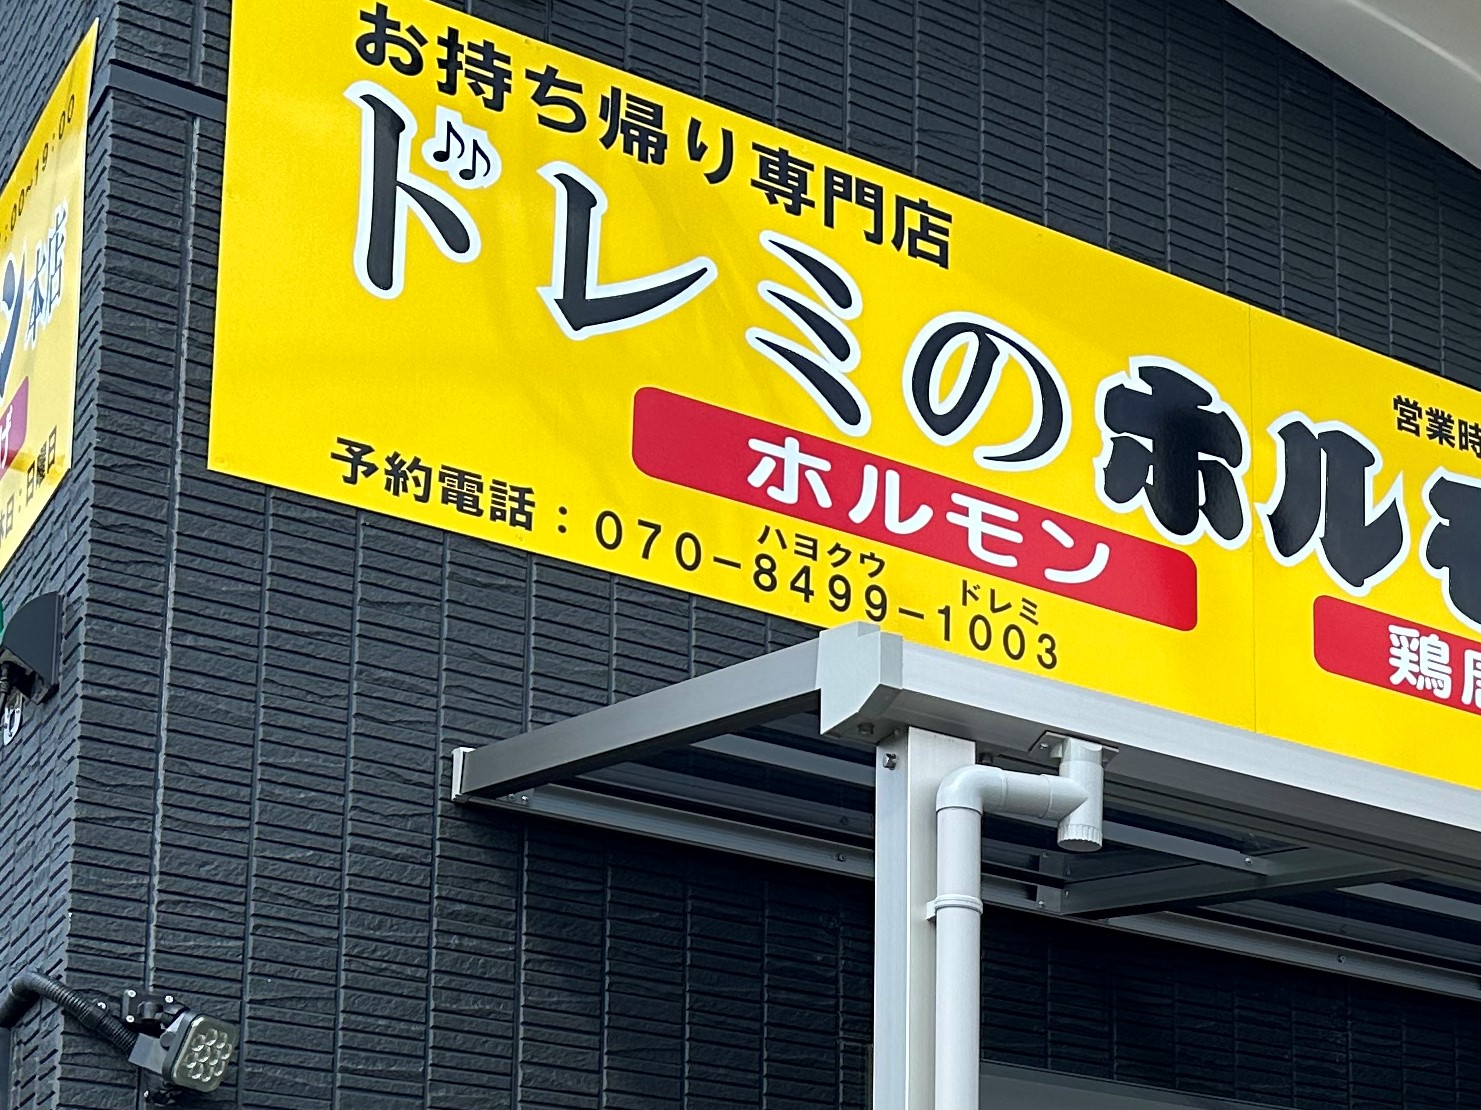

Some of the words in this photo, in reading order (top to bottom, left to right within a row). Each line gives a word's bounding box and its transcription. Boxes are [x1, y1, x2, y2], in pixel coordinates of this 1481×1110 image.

[354, 2, 954, 269] お持ち帰り専門店
[746, 436, 1111, 584] ホルモン
[757, 524, 886, 578] ハヨクウ
[960, 579, 1040, 626] ドレミ
